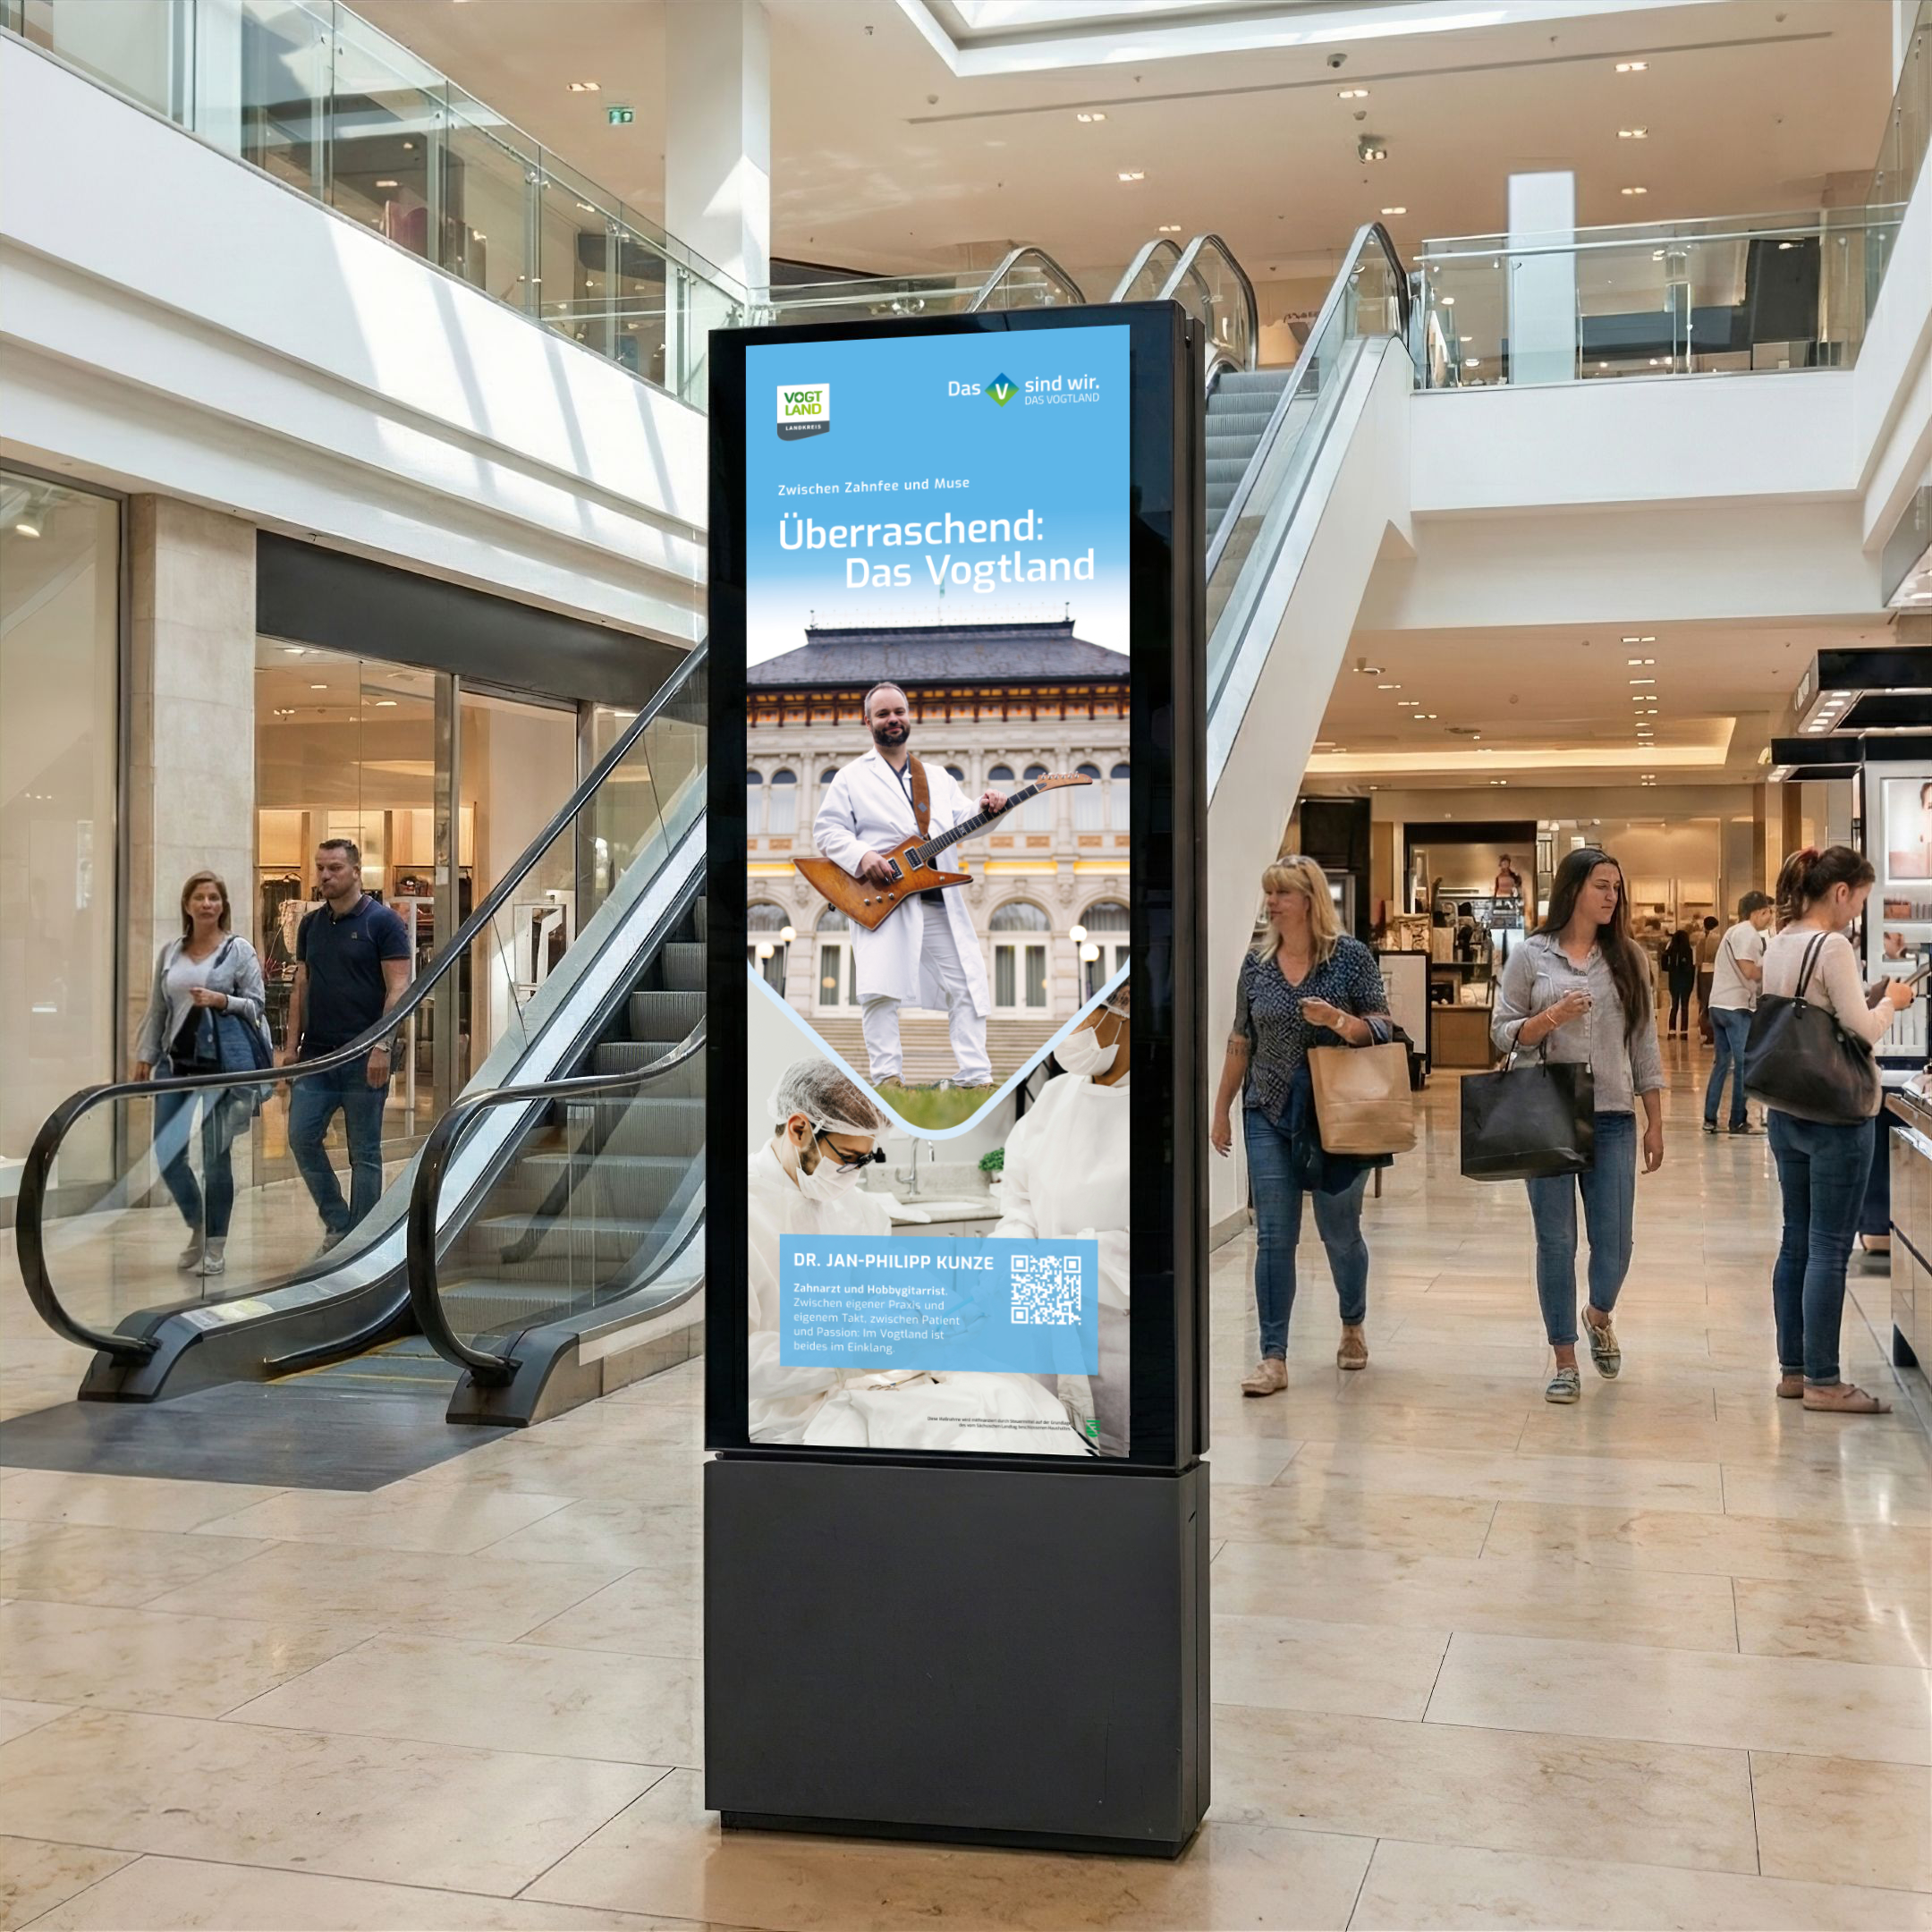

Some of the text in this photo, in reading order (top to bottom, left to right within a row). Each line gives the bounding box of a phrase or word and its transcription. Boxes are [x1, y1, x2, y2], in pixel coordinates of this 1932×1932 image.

[948, 374, 1100, 400] Das V sind wir.
[784, 390, 823, 403] VOGT
[1025, 393, 1100, 405] DAS VOGTLAND
[785, 402, 822, 416] LAND
[778, 477, 970, 496] Zwischen Zahnfee und Muse
[779, 509, 1044, 550] Überraschend:
[846, 548, 1095, 594] Das Vogtland
[794, 1253, 995, 1270] DR. JAN-PHILIPP KUNZE
[793, 1284, 948, 1297] Zahnarzt und Hobbygitarrist.
[793, 1298, 945, 1311] Zwischen eigener Praxis und
[793, 1313, 961, 1326] eigenem Takt, zwischen Patient
[793, 1327, 945, 1341] und Passion: Im Vogtland ist
[793, 1341, 895, 1355] beides im Einklang.
